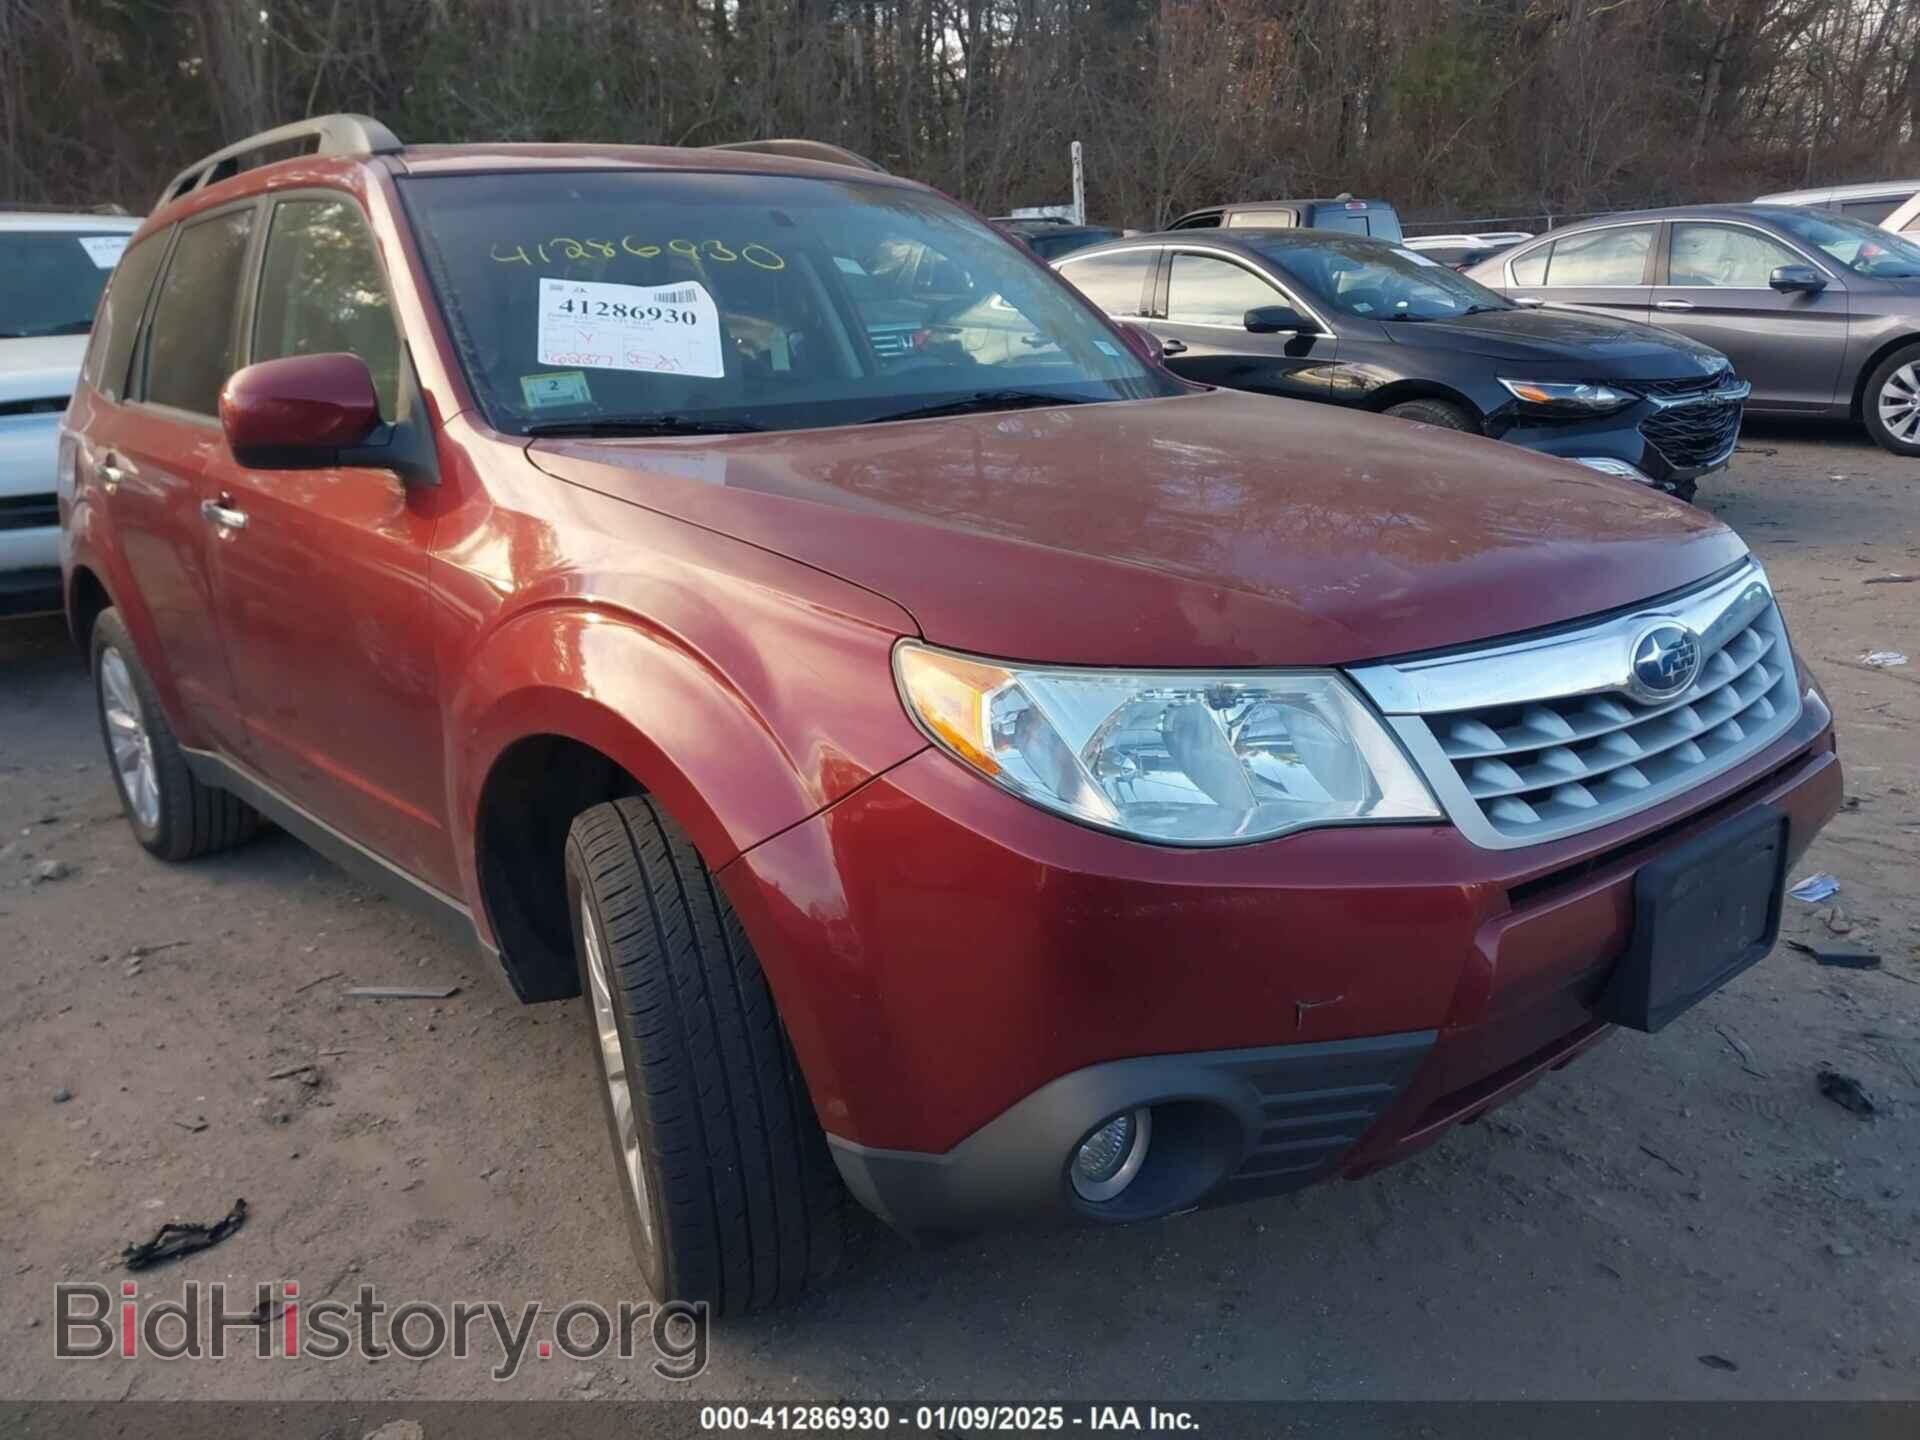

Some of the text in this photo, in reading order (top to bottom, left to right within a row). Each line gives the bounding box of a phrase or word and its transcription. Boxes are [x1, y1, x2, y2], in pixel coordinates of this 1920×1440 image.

[490, 236, 785, 270] 41286930
[558, 298, 697, 326] 41286930
[549, 380, 560, 391] 2
